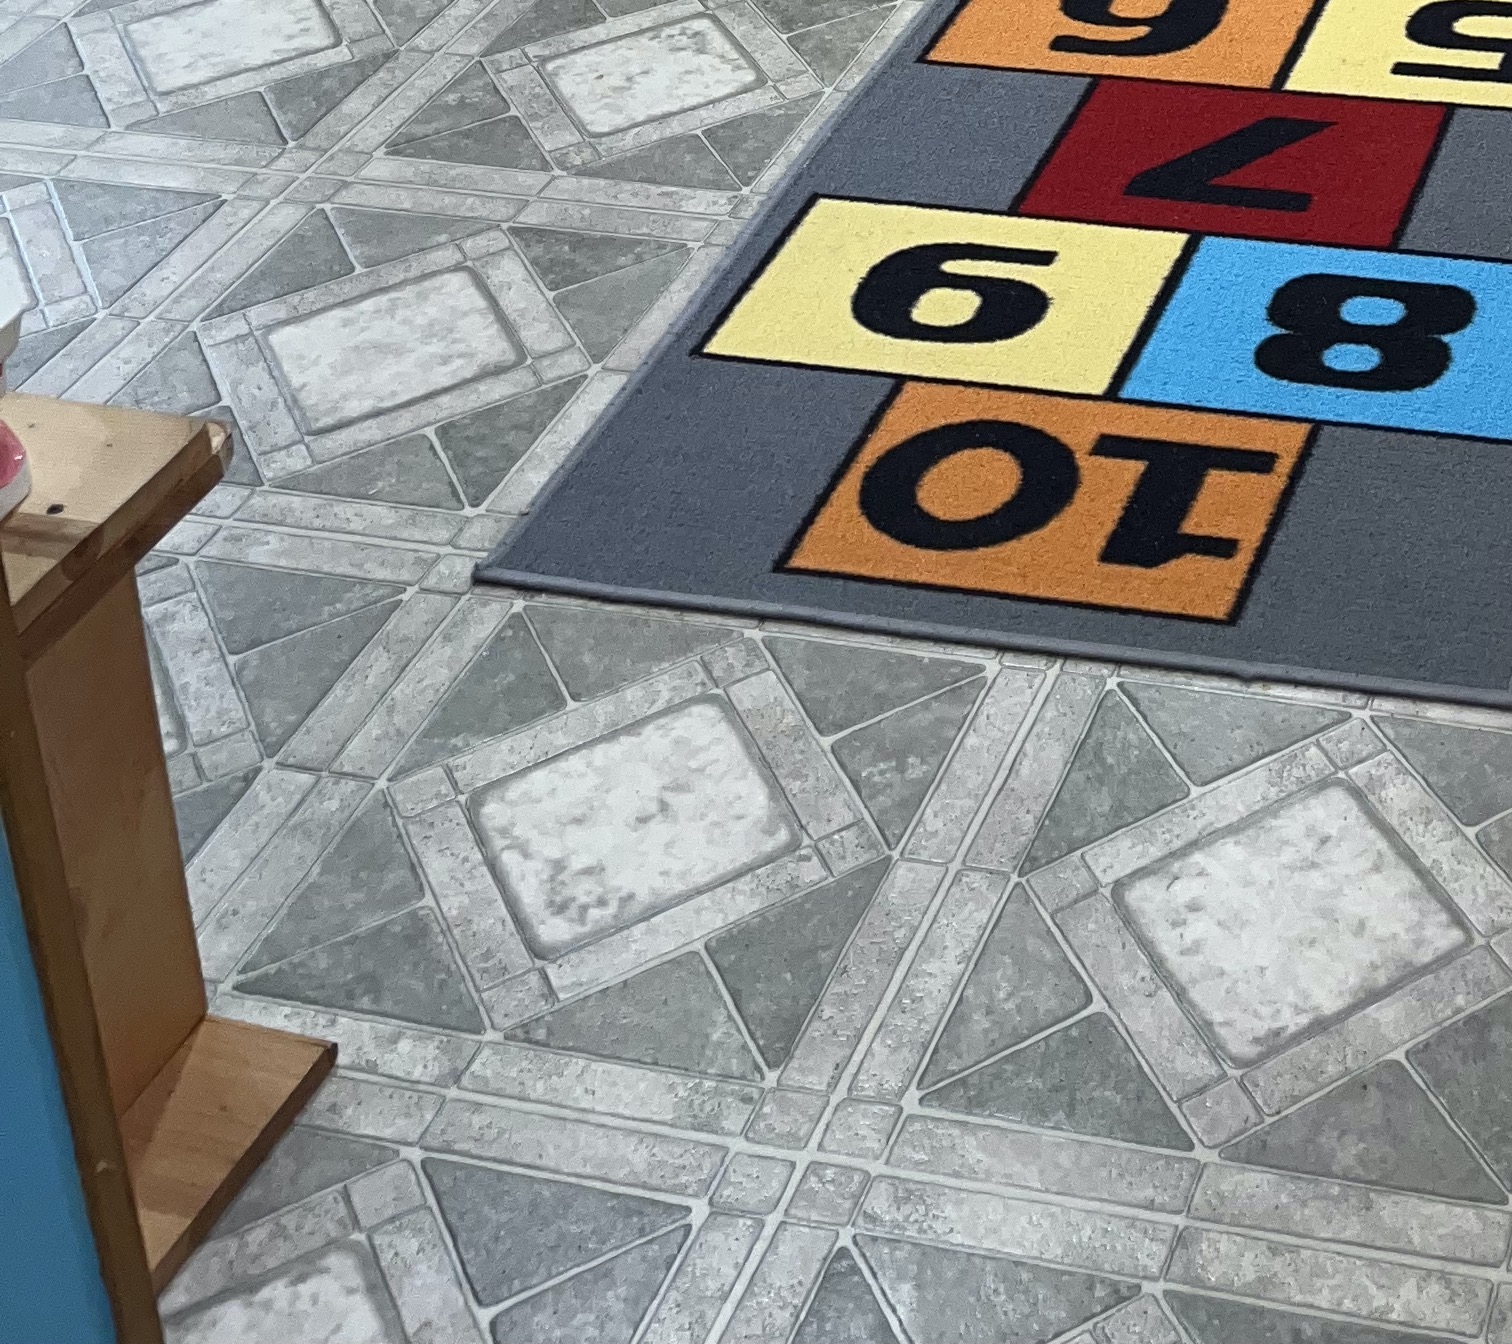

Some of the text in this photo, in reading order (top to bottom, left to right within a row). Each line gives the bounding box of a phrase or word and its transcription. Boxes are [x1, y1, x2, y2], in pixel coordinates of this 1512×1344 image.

[1123, 117, 1338, 213] 7
[852, 243, 1057, 343] 9
[1255, 274, 1476, 391] 8
[858, 420, 1278, 569] 10
